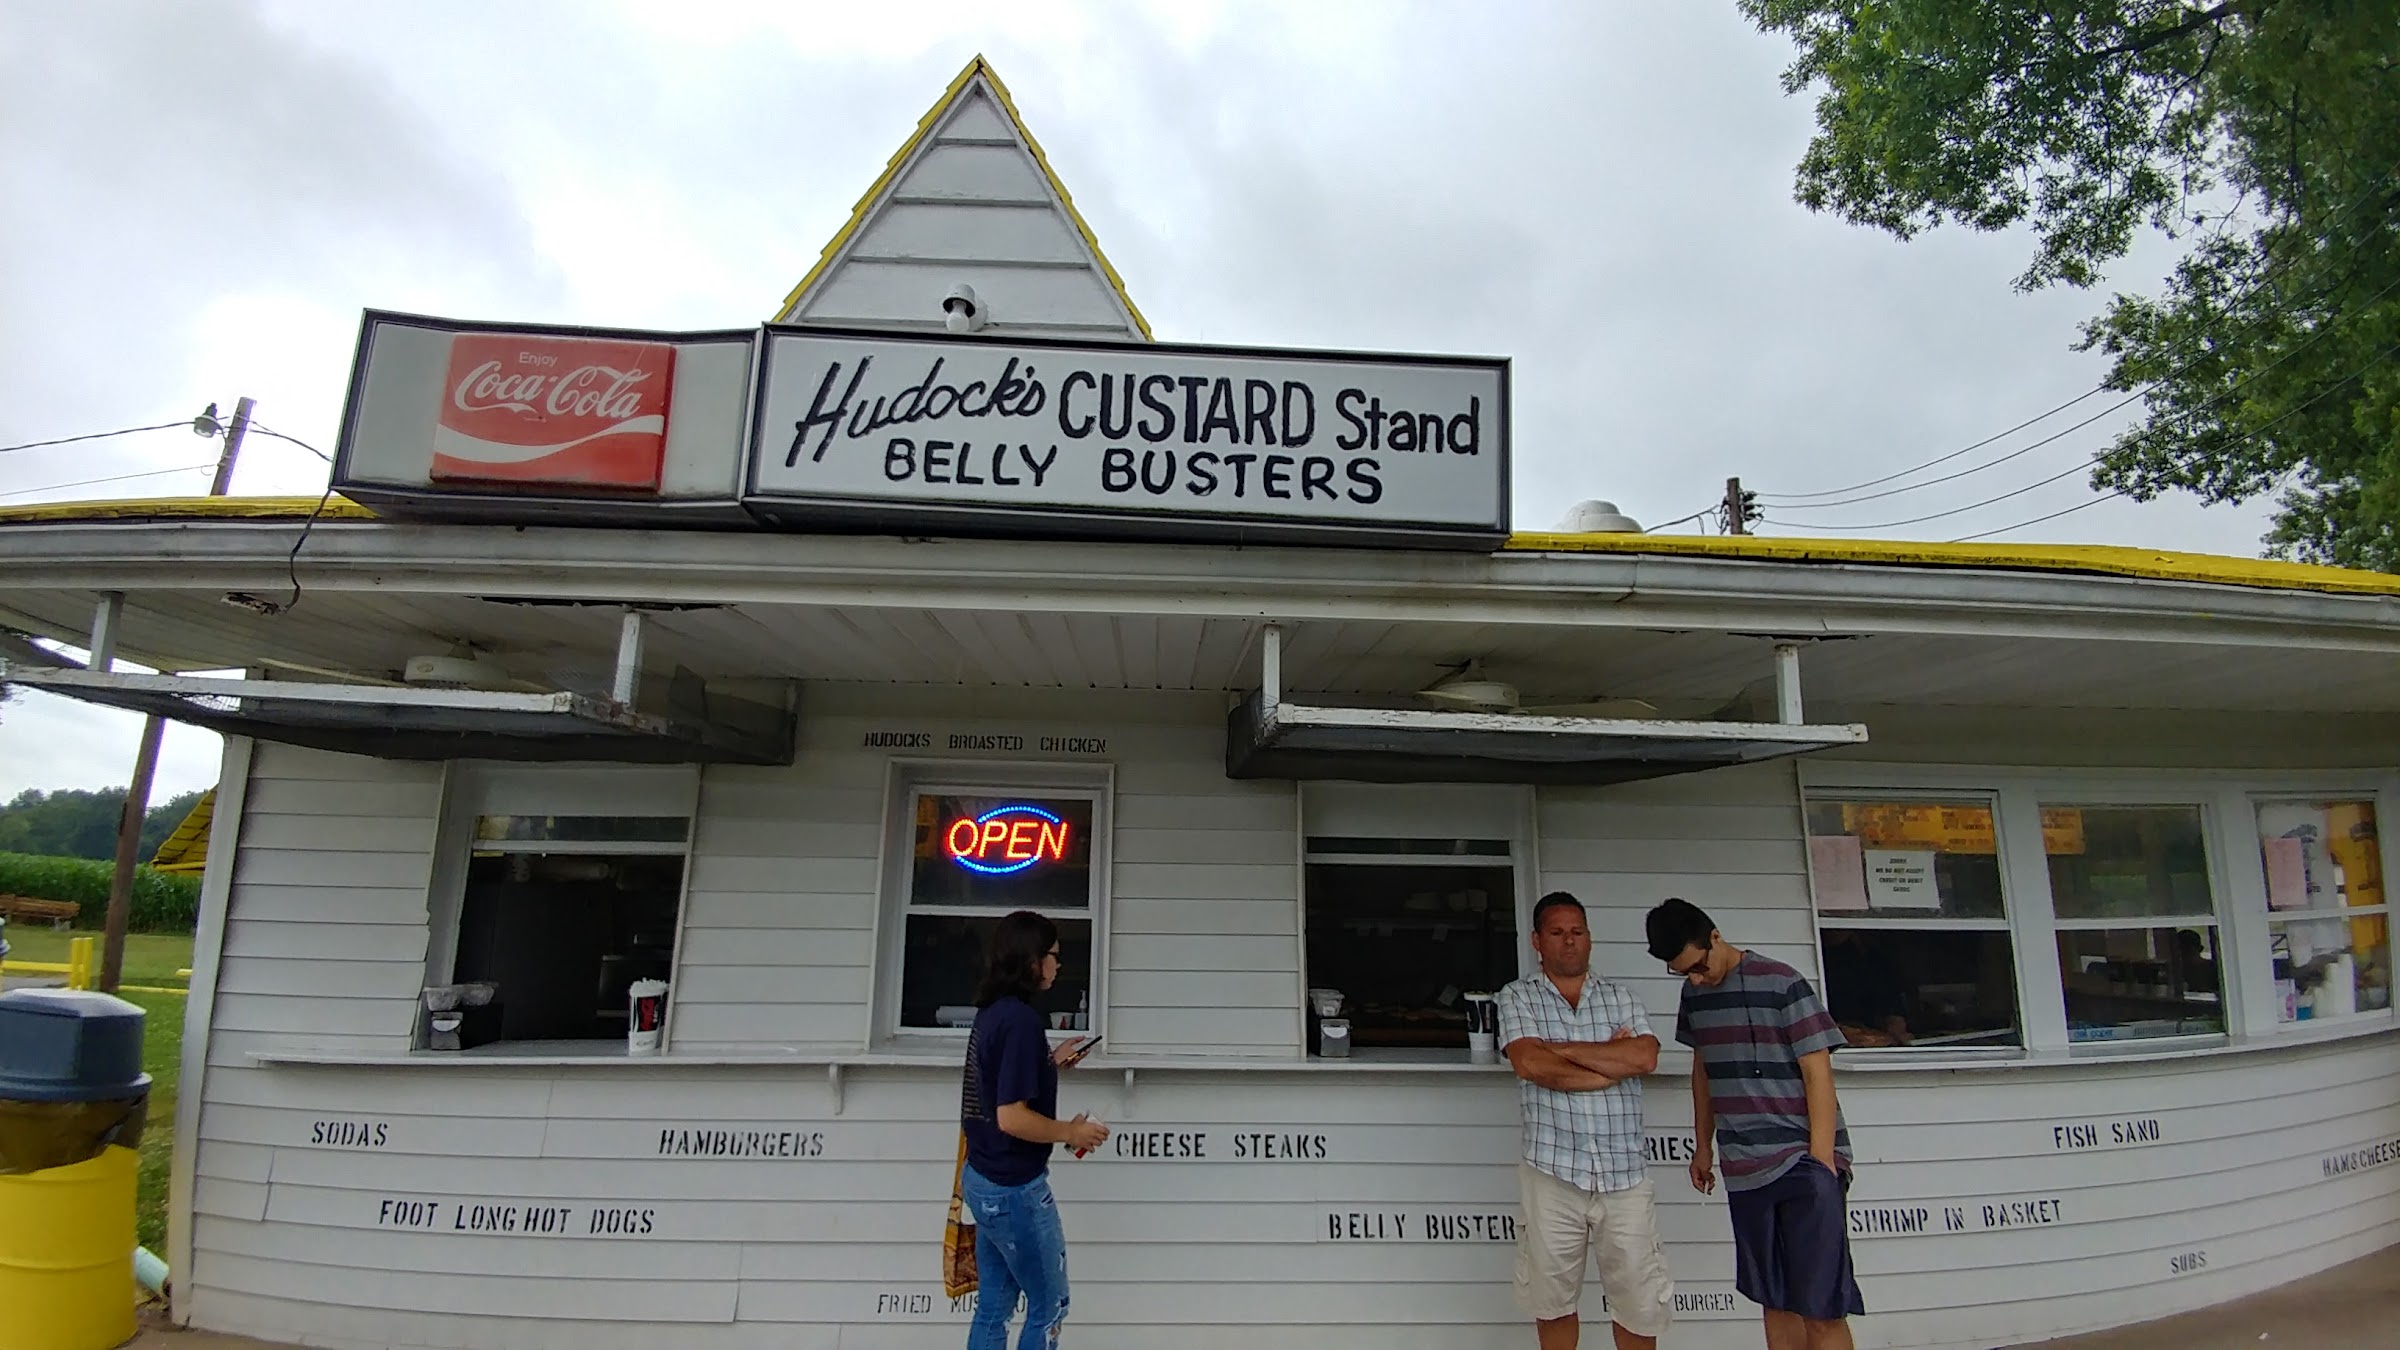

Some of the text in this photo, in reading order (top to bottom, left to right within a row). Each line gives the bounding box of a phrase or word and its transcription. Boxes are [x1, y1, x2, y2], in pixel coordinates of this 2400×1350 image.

[519, 351, 558, 369] Enjoy
[454, 360, 652, 418] Coca-Cola
[785, 354, 1480, 468] Hudock's CUSTARD Stand
[884, 438, 1383, 504] BELLY BUSTERS
[864, 732, 1107, 754] HUDOCKS BROASTED CHICKEN
[948, 817, 1068, 859] OPEN
[311, 1121, 389, 1147] SODAS
[659, 1129, 825, 1158] HAMBURGERS
[1115, 1132, 1328, 1159] CHEESE STEAKS
[2054, 1119, 2160, 1149] FISH SAND
[378, 1199, 656, 1235] FOOT LONG HOT DOGS
[1329, 1213, 1407, 1240] BELLY
[1849, 1199, 2061, 1233] SHRIMP IN BASKET
[2170, 1250, 2208, 1275] SUBS
[877, 1294, 932, 1314] FRIED
[1674, 1293, 1736, 1312] BURGER
